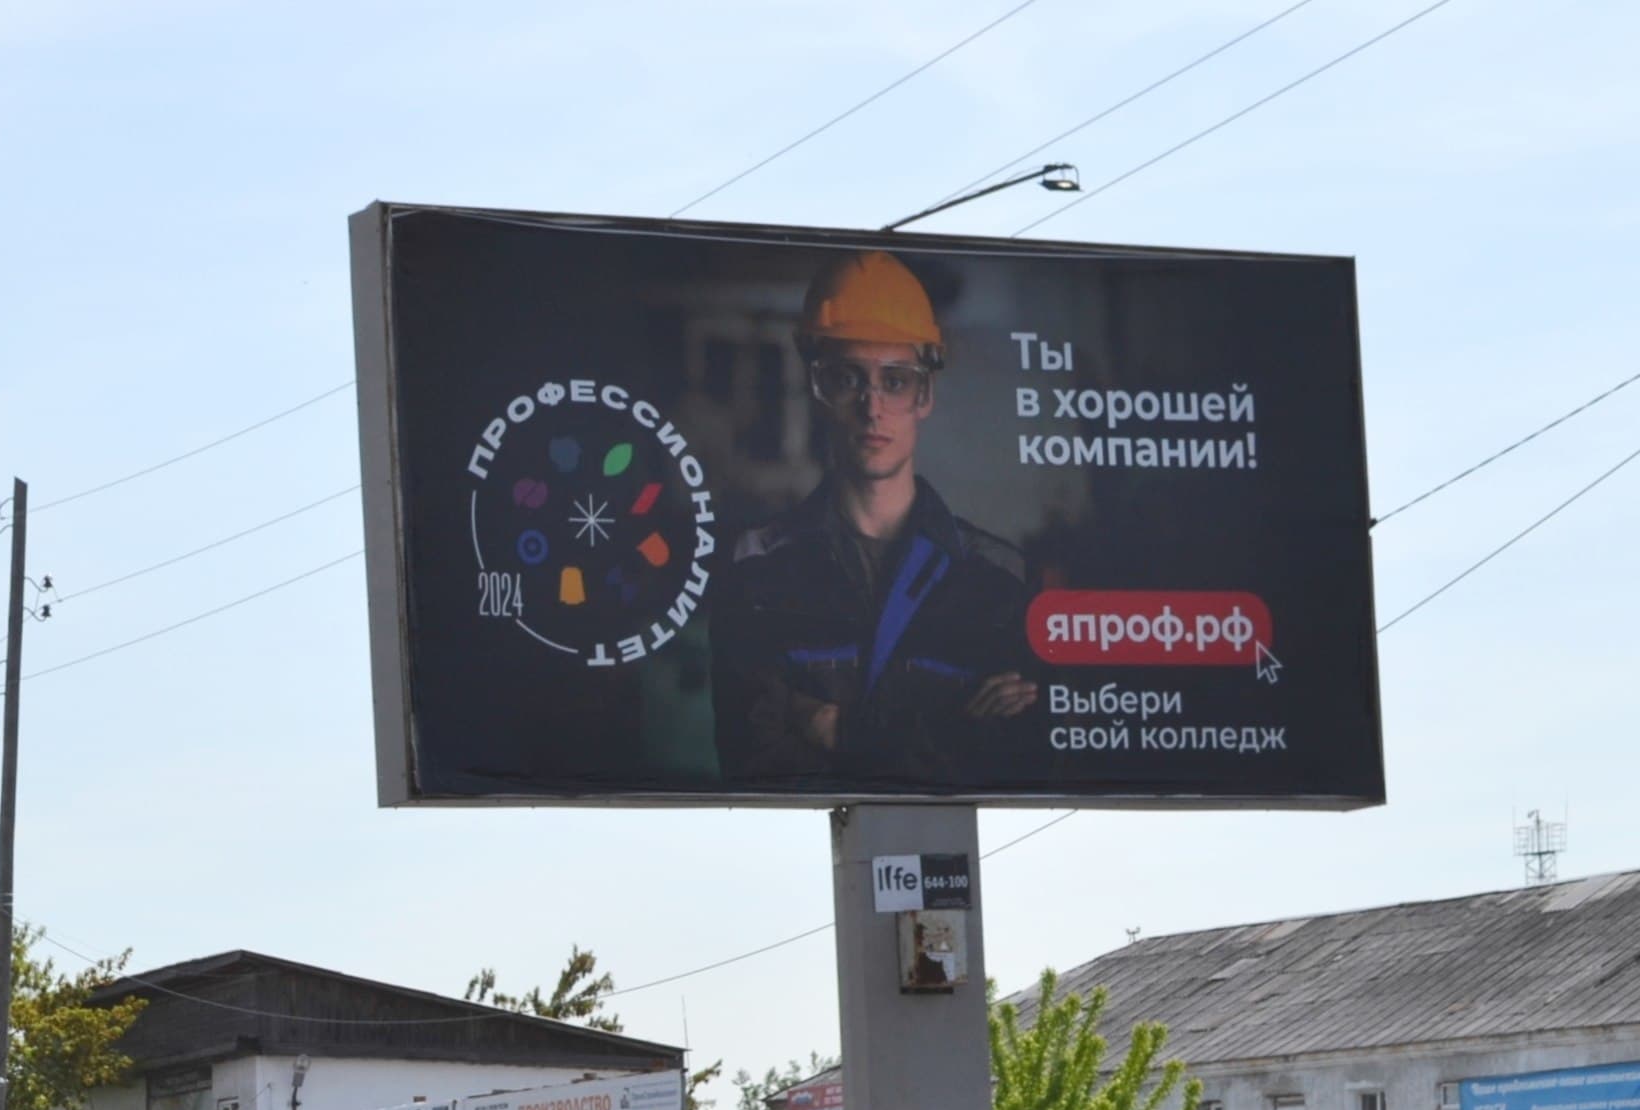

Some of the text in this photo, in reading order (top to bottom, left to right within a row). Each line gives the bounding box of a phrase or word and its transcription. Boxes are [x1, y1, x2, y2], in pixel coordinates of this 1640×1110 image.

[1011, 332, 1073, 371] Ты
[1016, 383, 1255, 429] в хорошей
[1017, 432, 1258, 470] компании!
[468, 377, 717, 667] ПРОФЕССИОНАЛИТЕТ
[478, 571, 524, 617] 2024
[1047, 609, 1254, 656] япроф.рф
[1049, 686, 1181, 723] Выбери
[1050, 720, 1287, 752] свой колледж
[924, 875, 968, 889] 644-100
